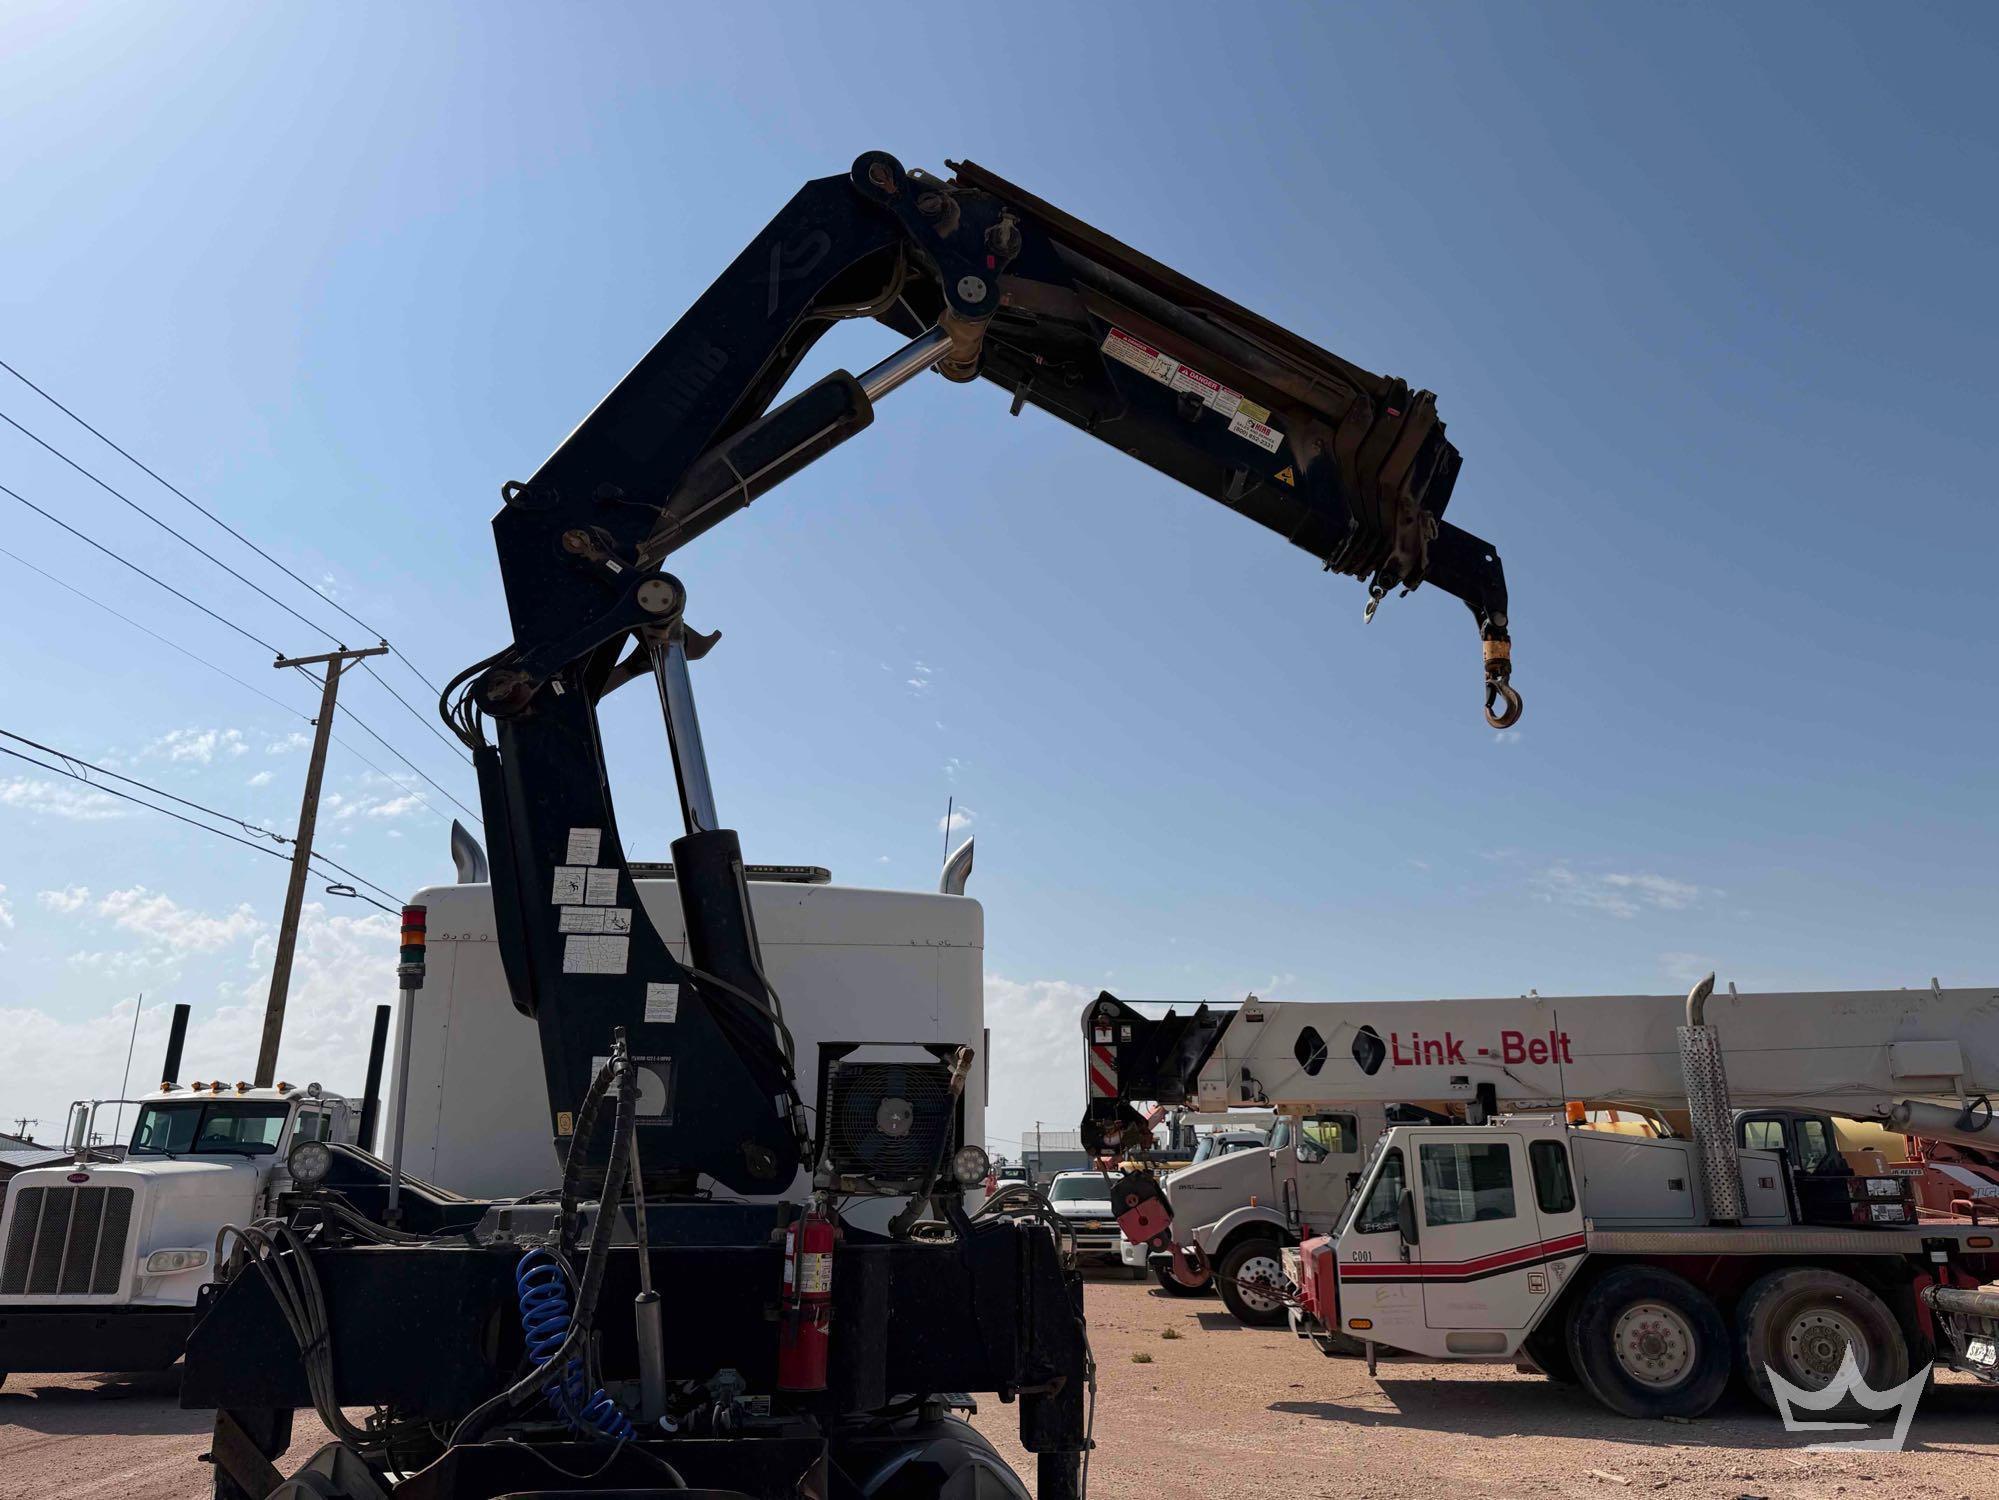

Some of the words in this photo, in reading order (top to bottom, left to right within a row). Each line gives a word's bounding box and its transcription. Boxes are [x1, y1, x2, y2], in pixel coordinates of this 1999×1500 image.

[1189, 371, 1218, 391] DANGER
[1254, 423, 1271, 437] HIAB
[1391, 1032, 1467, 1066] Link
[1501, 1030, 1573, 1066] Belt
[1352, 1250, 1373, 1262] C001
